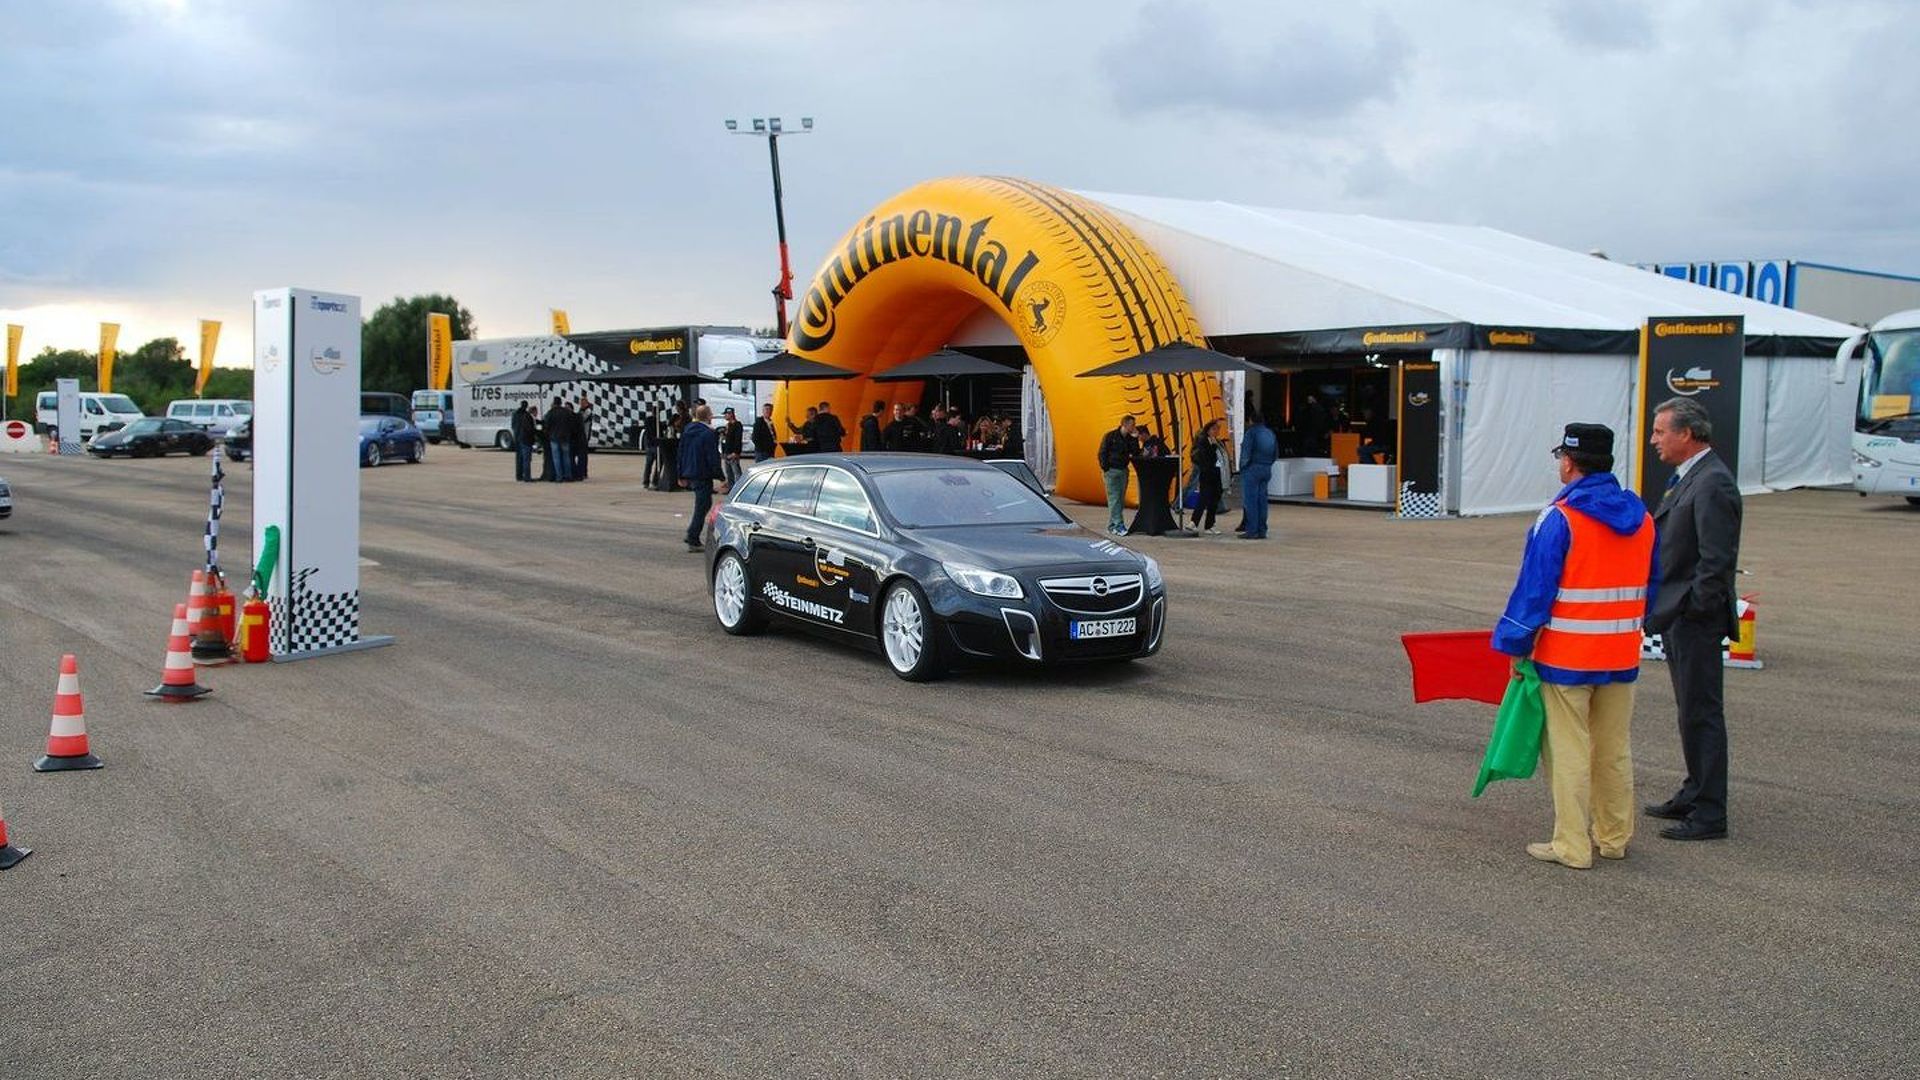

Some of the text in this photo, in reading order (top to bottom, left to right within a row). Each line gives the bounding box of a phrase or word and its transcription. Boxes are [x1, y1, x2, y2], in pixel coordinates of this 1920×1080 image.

[793, 209, 1040, 351] Continental
[1363, 330, 1416, 345] Continental
[1655, 321, 1723, 337] Continental
[630, 338, 675, 355] Continental
[471, 382, 501, 400] tires
[776, 593, 844, 624] STEINMETZ
[1079, 620, 1134, 636] AC ST 222
